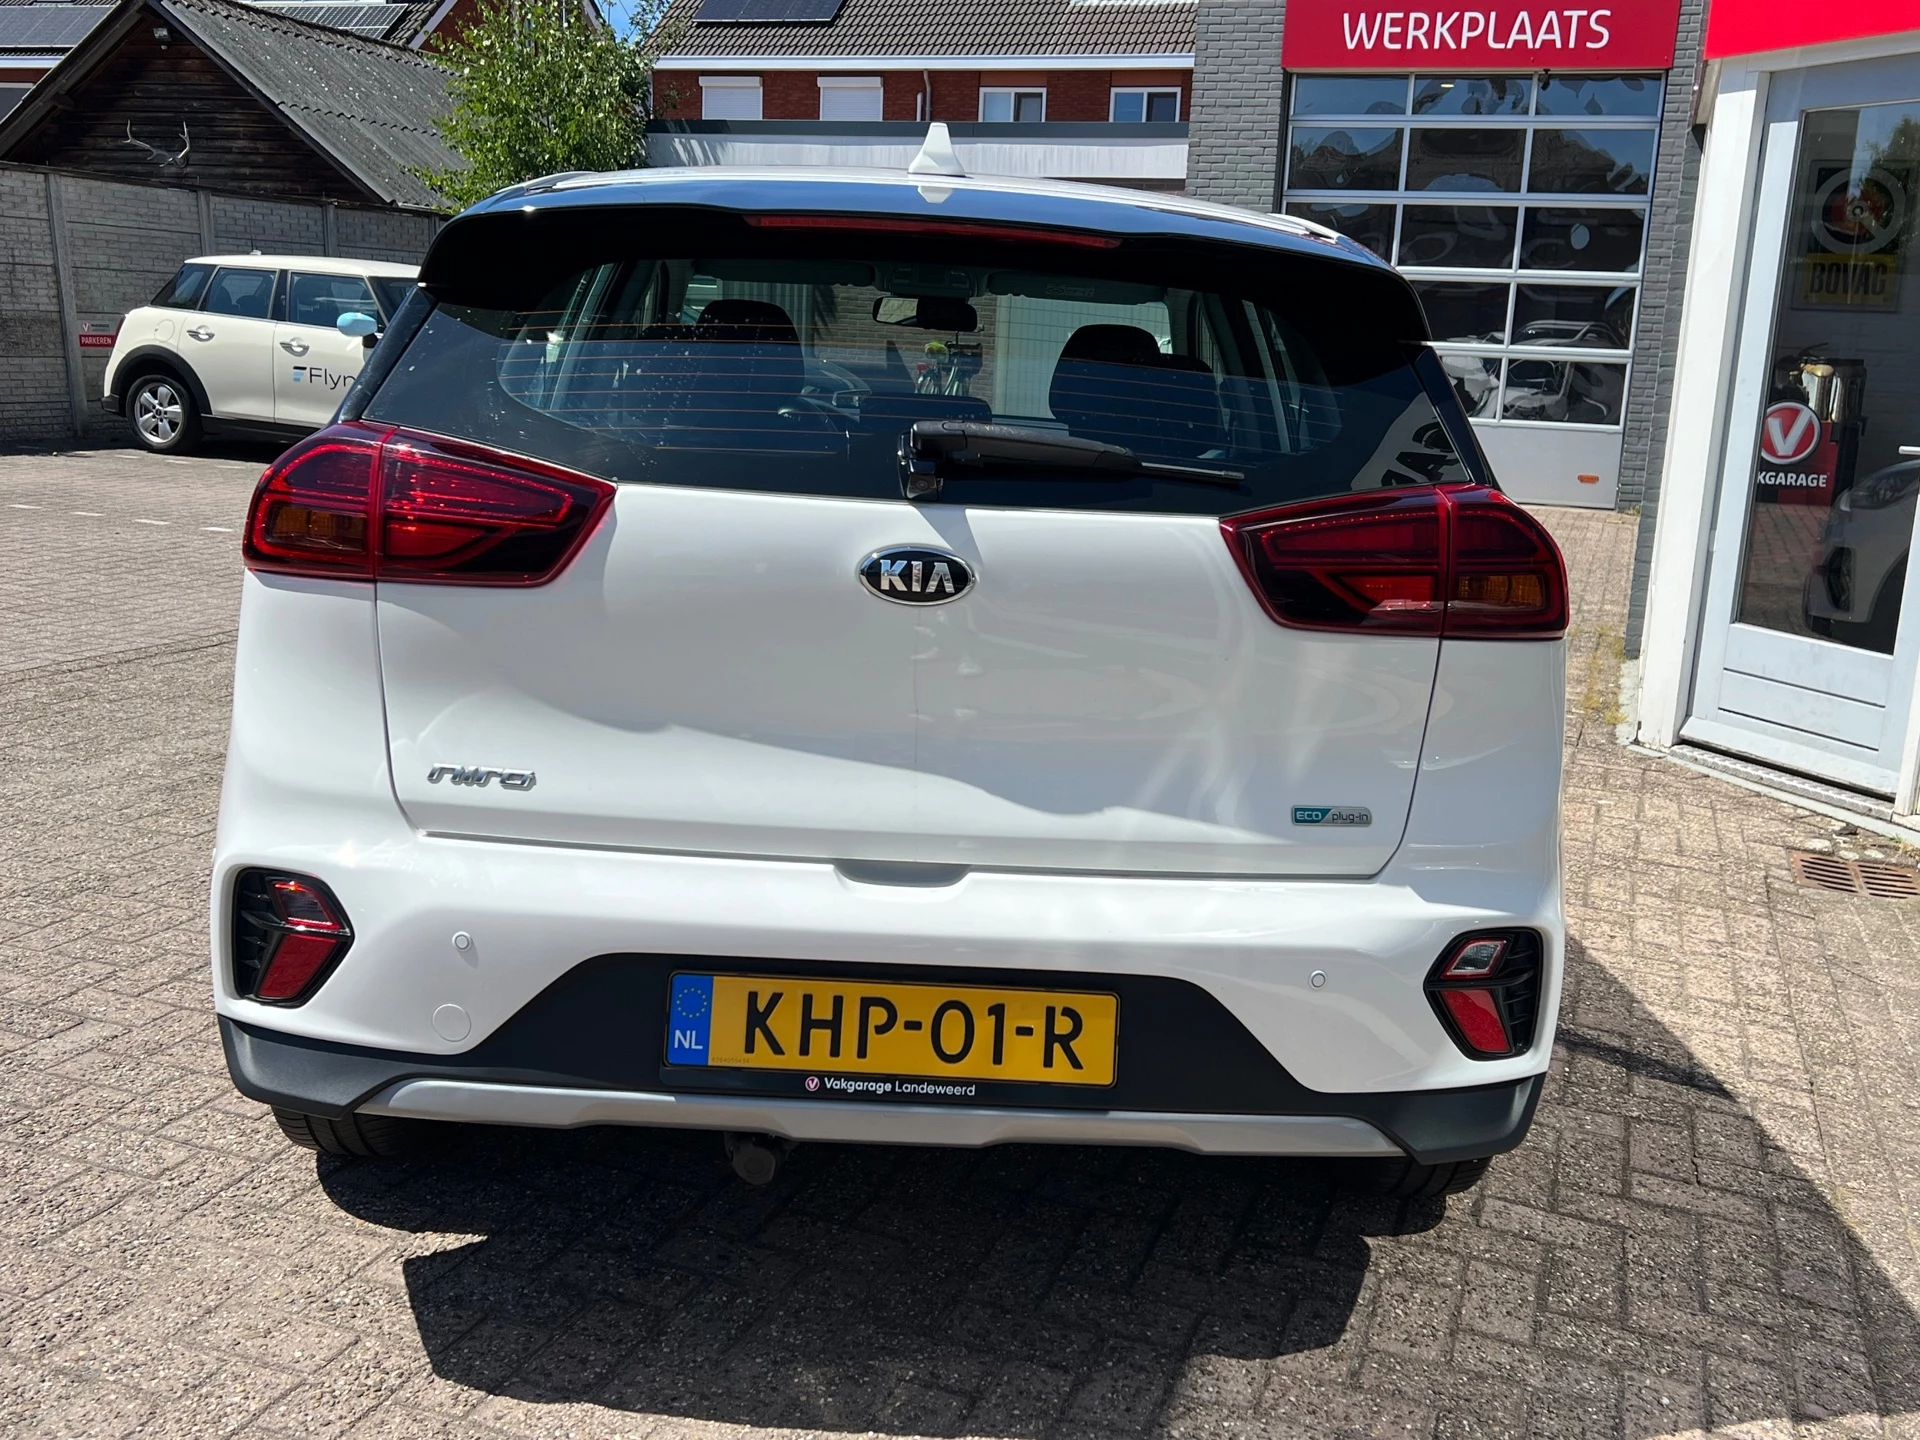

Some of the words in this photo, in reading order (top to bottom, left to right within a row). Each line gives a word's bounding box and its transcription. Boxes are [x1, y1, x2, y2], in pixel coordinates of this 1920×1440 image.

[1342, 9, 1612, 50] WERKPLAATS
[81, 336, 112, 345] PARKEREN
[880, 559, 956, 594] KIA
[1296, 811, 1322, 820] ECO
[1331, 811, 1369, 824] plug-in
[674, 1029, 704, 1050] NL
[744, 990, 1085, 1069] KHP-01-R
[824, 1077, 893, 1094] Vakgarage
[895, 1080, 976, 1096] Landeweerd
